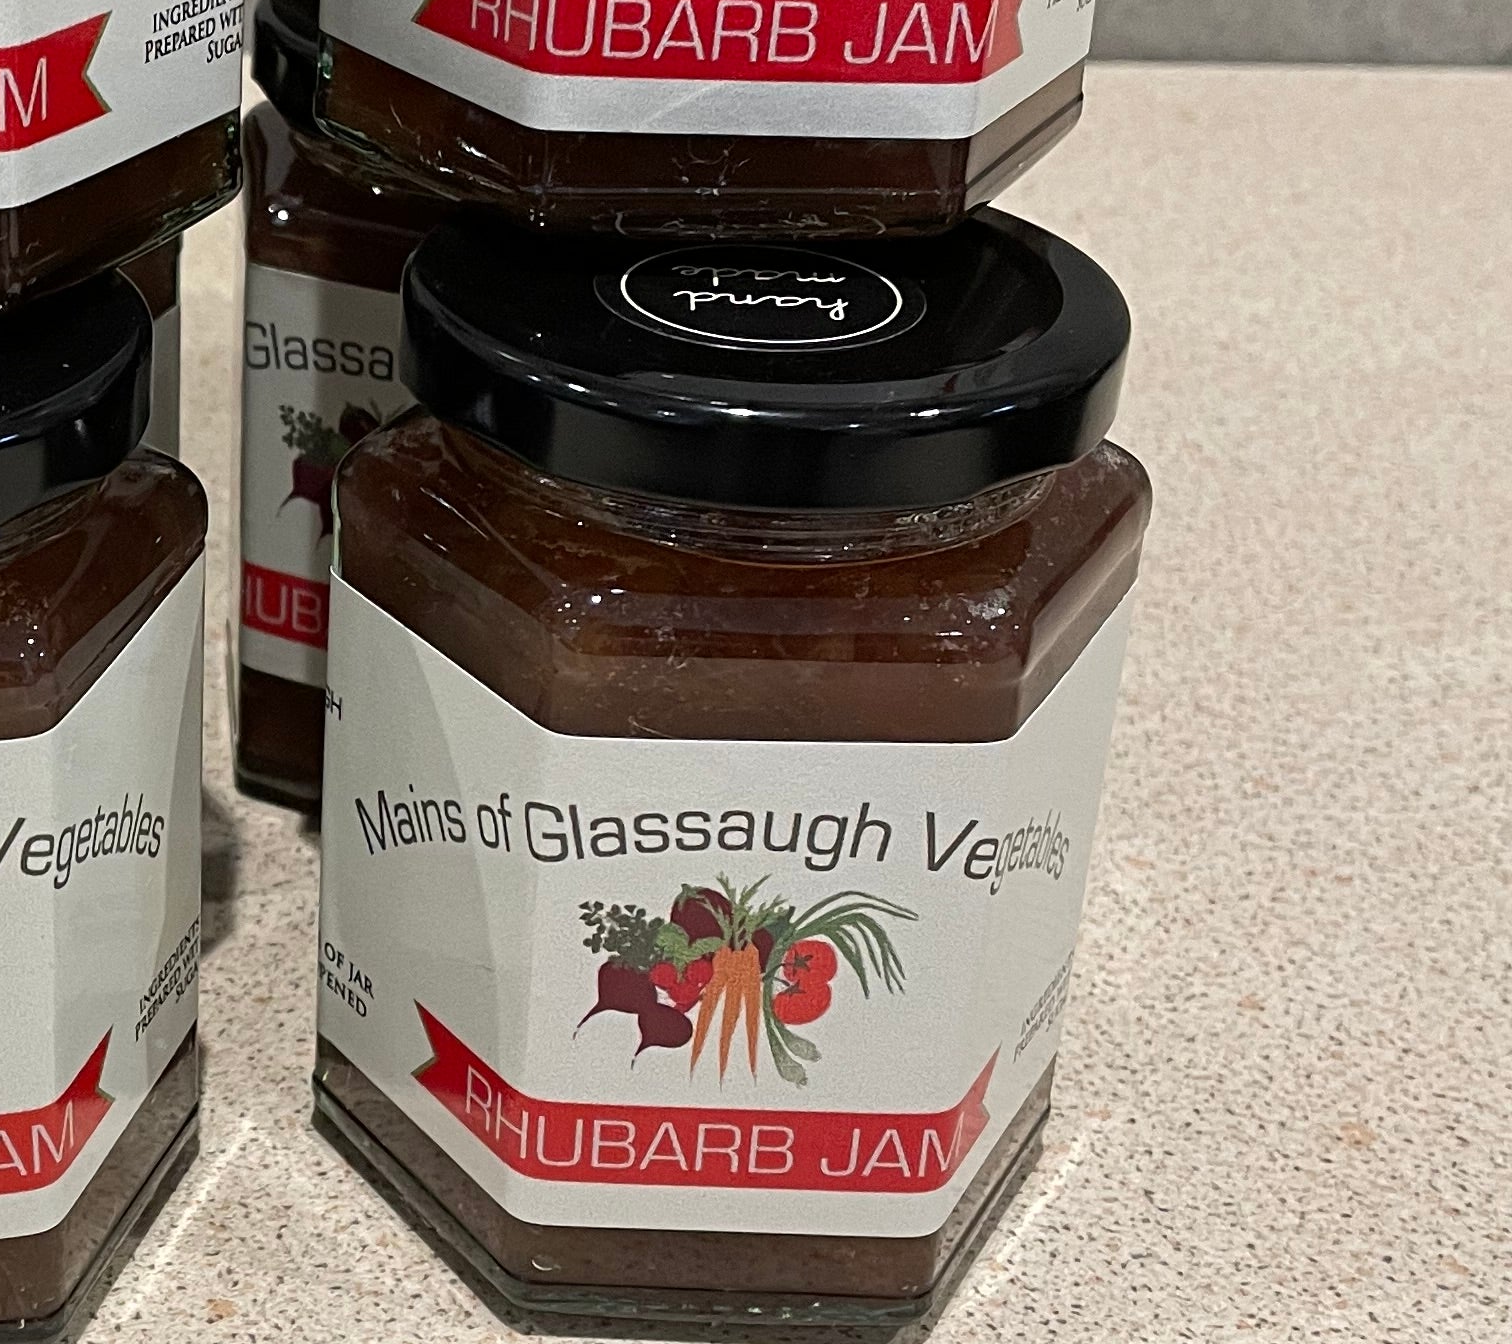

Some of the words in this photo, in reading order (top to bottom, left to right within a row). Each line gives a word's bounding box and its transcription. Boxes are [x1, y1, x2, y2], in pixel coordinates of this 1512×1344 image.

[144, 17, 216, 64] PREPARED
[206, 31, 243, 64] SUGA
[672, 290, 848, 321] hand
[245, 321, 395, 383] Glassa
[355, 783, 466, 856] Mains
[475, 791, 514, 853] of
[524, 800, 891, 872] Glassaugh
[922, 809, 1070, 894] Vegetables
[318, 960, 367, 1017] PENED
[324, 942, 345, 969] OF
[348, 961, 374, 999] JAR
[463, 1066, 796, 1176] RHUBARB
[819, 1114, 968, 1178] JAM
